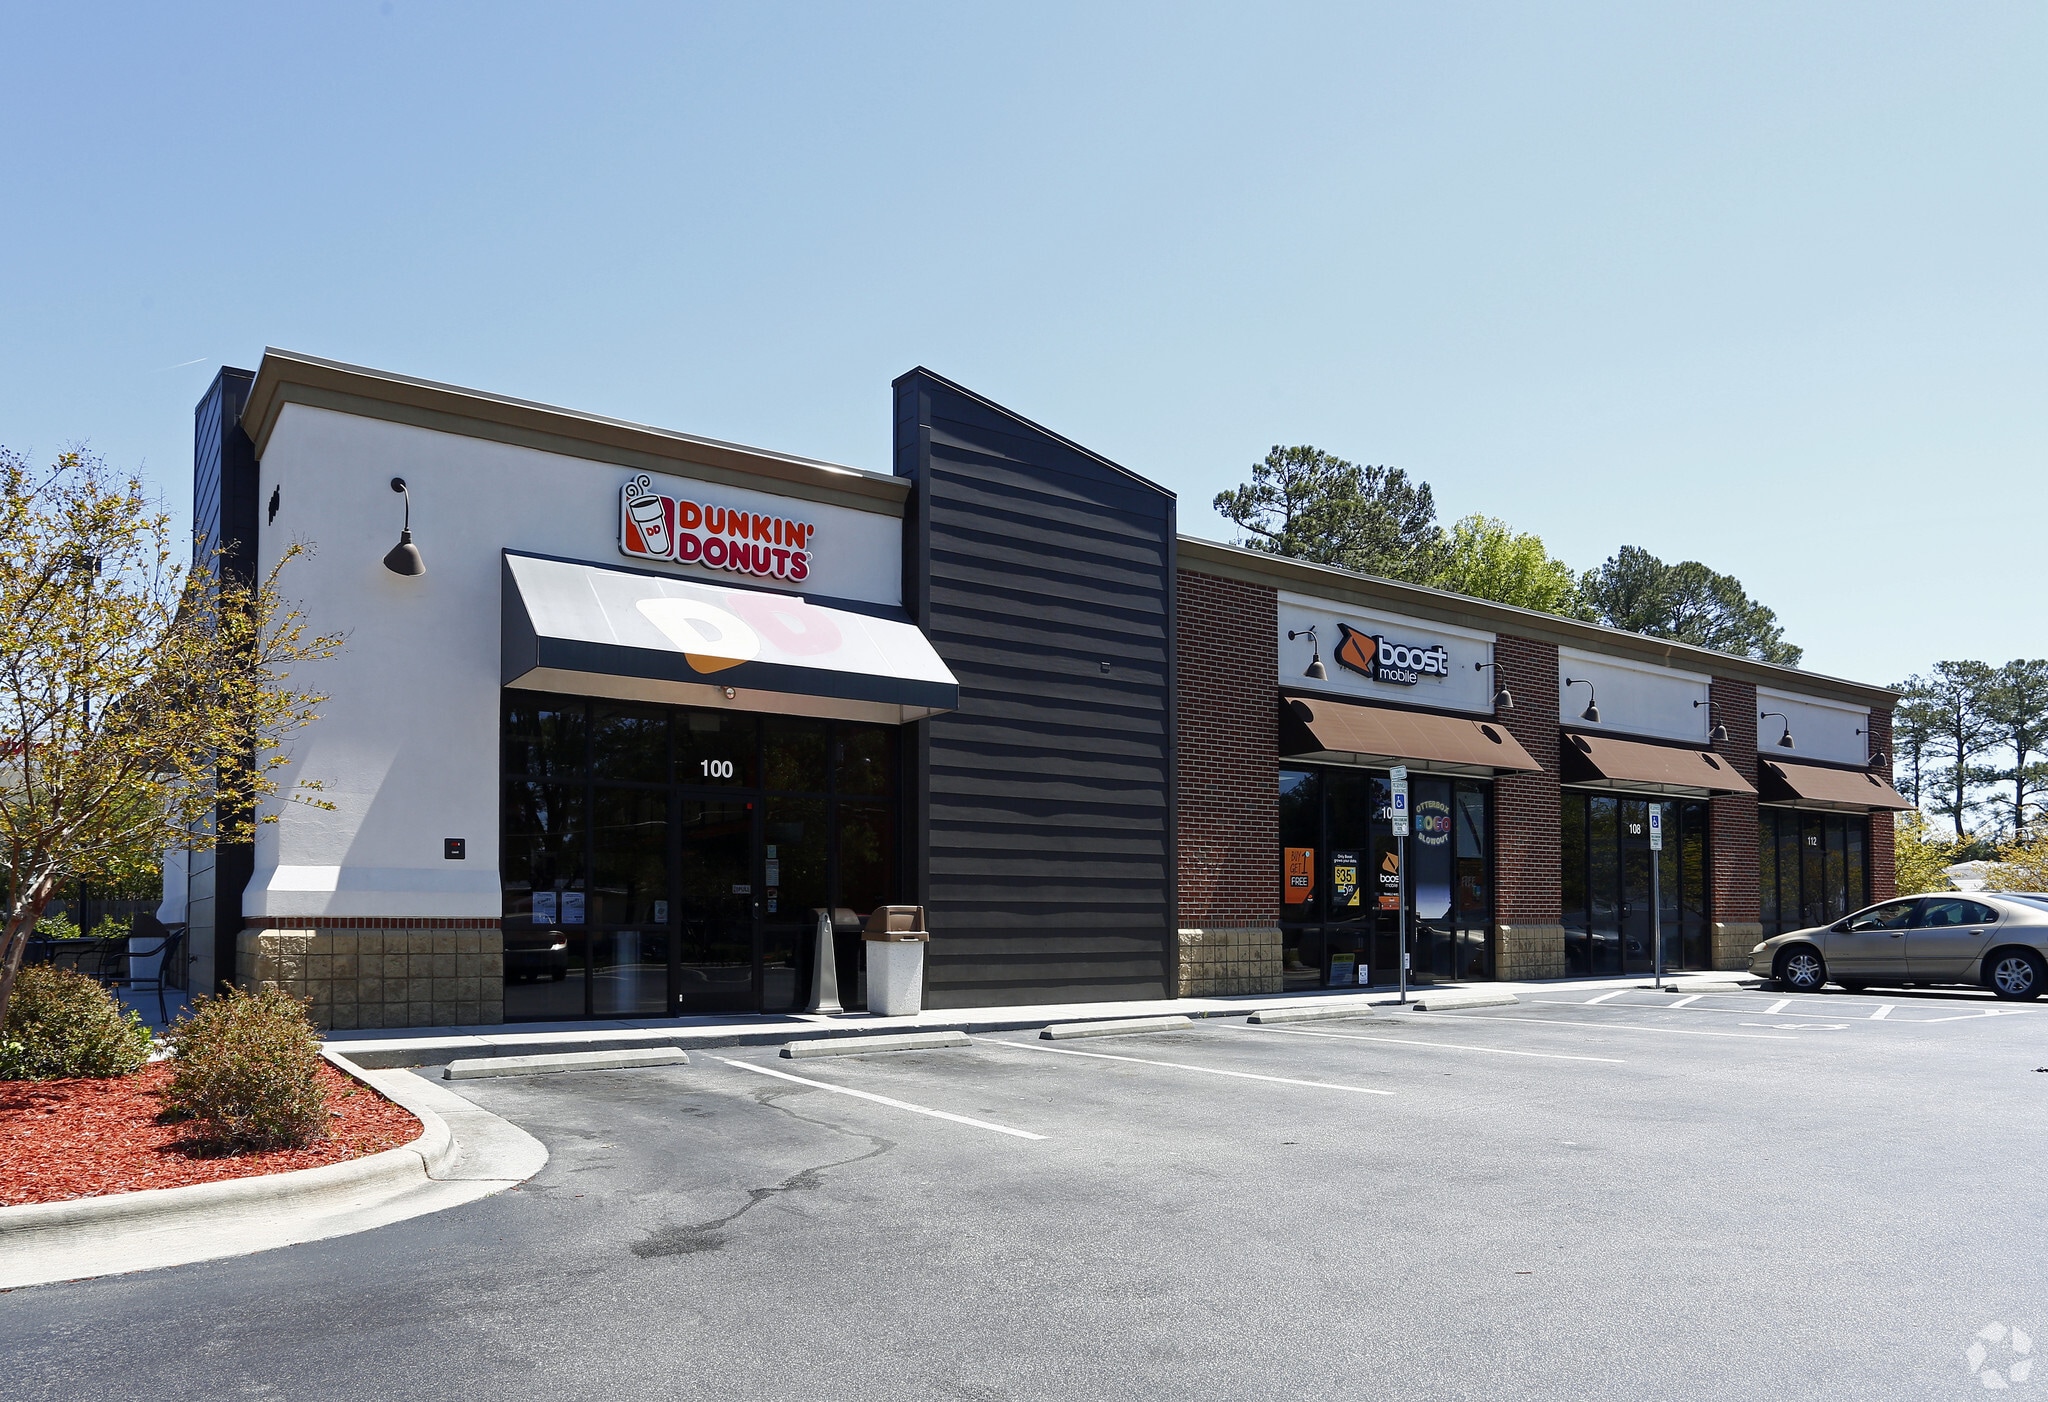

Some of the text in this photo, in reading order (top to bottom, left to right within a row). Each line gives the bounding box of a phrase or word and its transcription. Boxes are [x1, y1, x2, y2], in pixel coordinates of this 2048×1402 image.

[645, 525, 660, 536] DD
[680, 501, 814, 549] DUNKIN'
[680, 533, 808, 579] DONUTS
[1379, 637, 1447, 675] boost
[1380, 668, 1417, 683] mobile
[701, 760, 733, 778] 100
[1416, 801, 1450, 814] OTTERBOX
[1415, 814, 1451, 832] BOGO
[1629, 824, 1641, 834] 108
[1808, 836, 1817, 846] 112
[1291, 877, 1308, 886] FREE
[1380, 873, 1399, 883] boos
